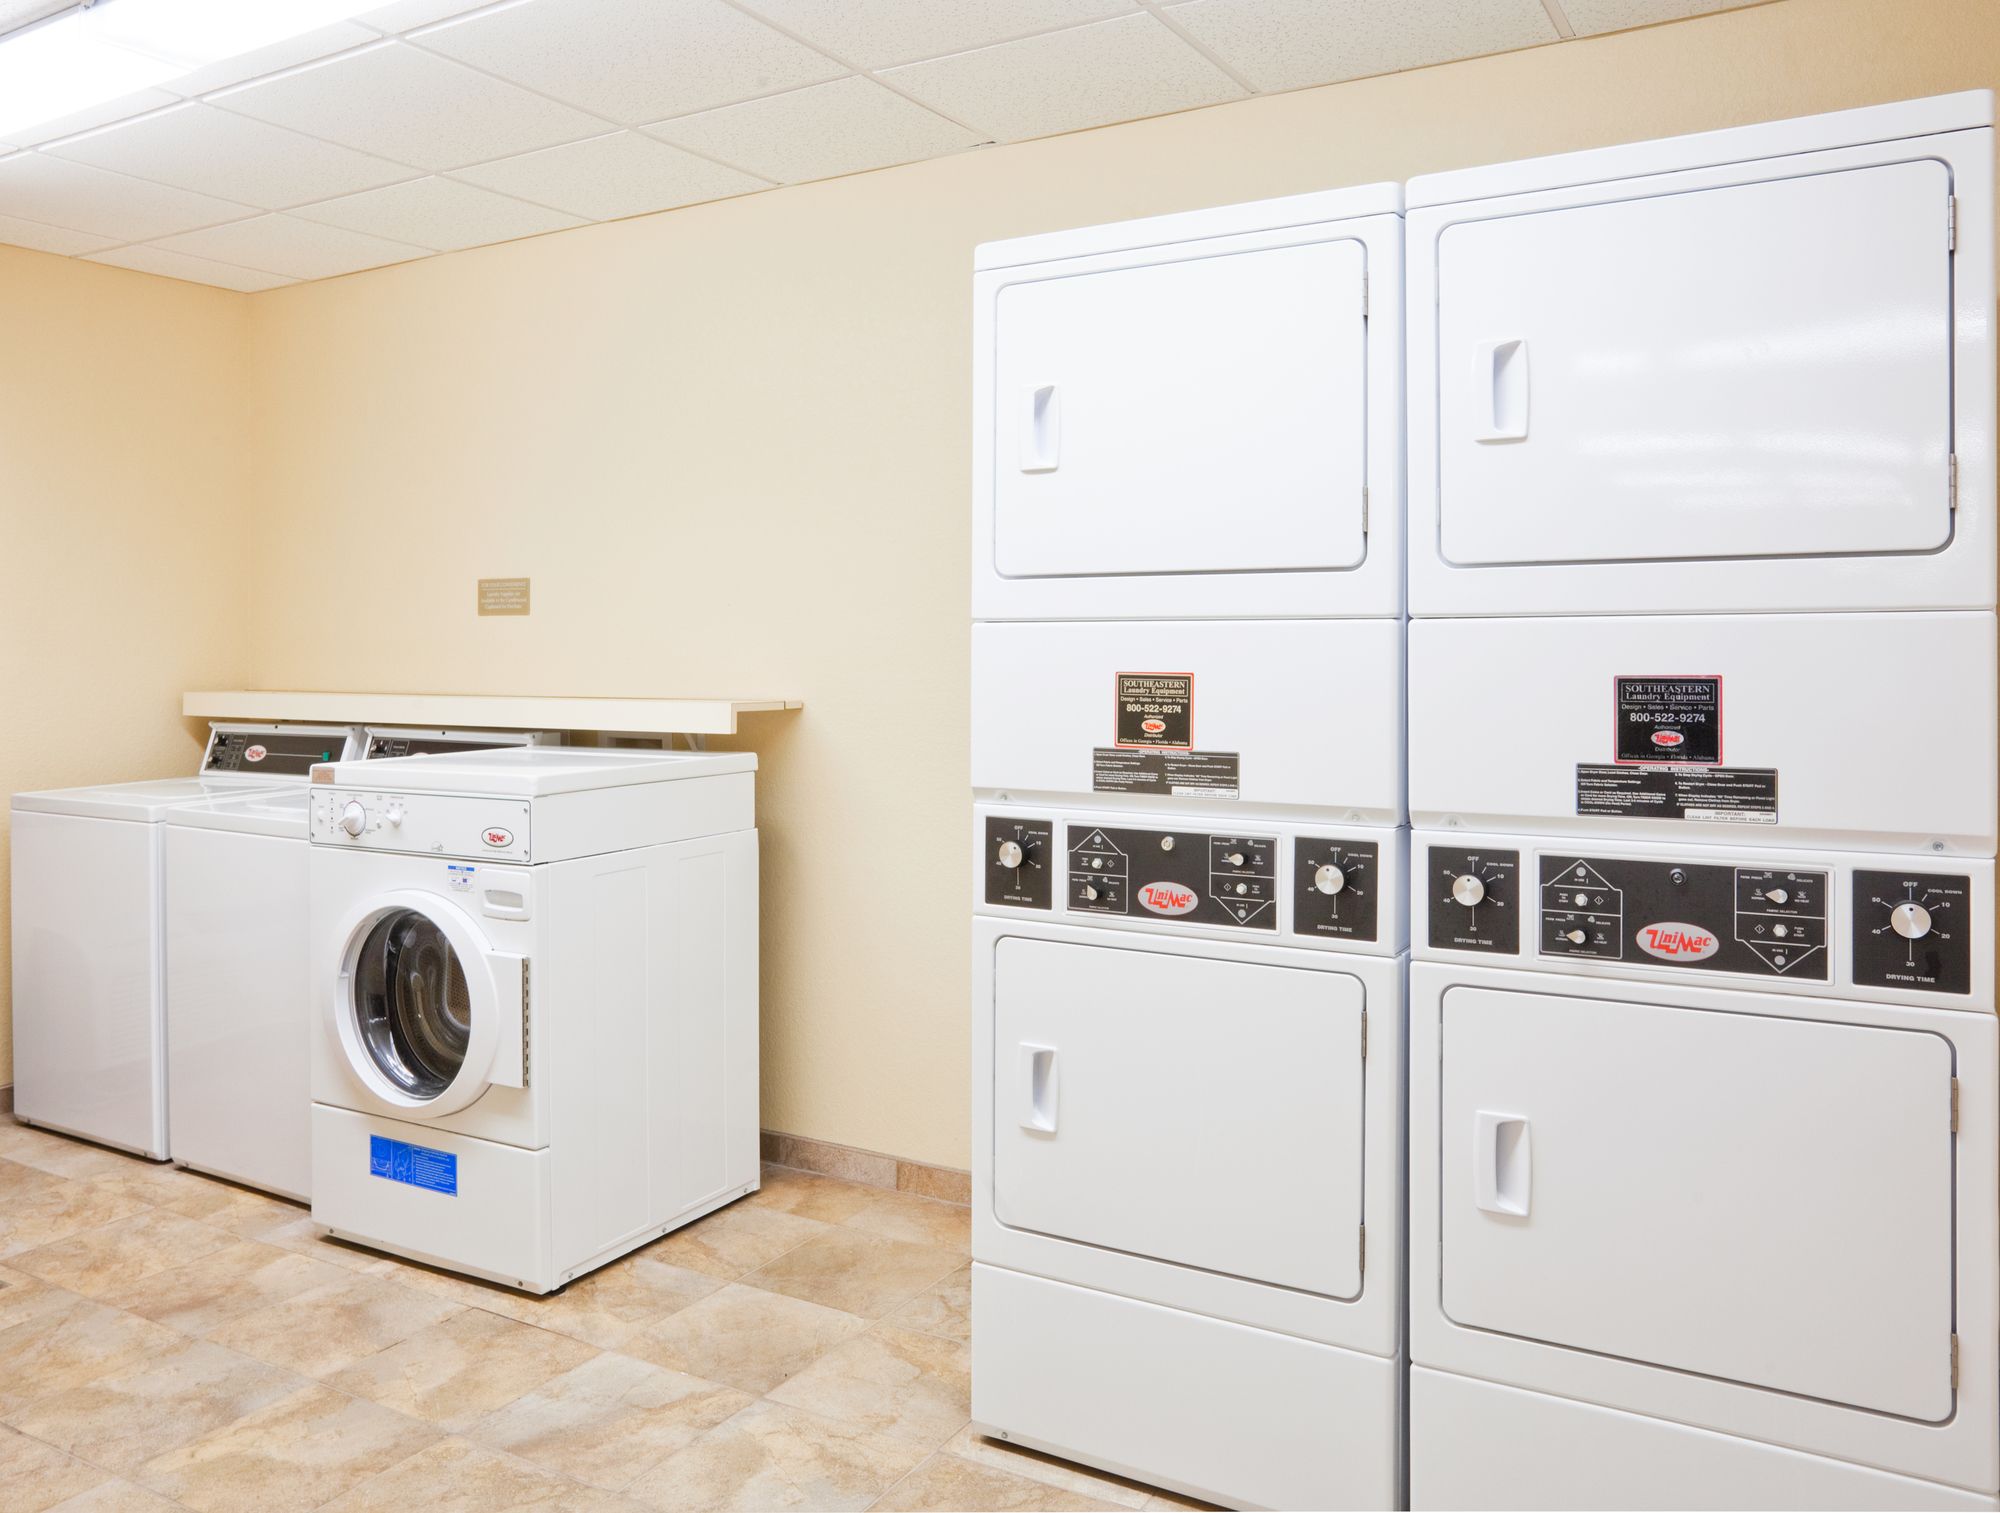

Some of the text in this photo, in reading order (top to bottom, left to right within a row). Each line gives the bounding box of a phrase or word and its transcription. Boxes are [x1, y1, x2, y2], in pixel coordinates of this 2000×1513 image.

[1124, 680, 1185, 688] SOUTHEASTERN
[1625, 685, 1710, 694] SOUTHEASTERN
[1626, 693, 1710, 702] Laundry Equipment
[1126, 704, 1181, 714] 800-522-9274
[1630, 713, 1705, 723] 800-522-9274
[1145, 887, 1192, 909] UniMac
[1646, 929, 1711, 954] UniMac
